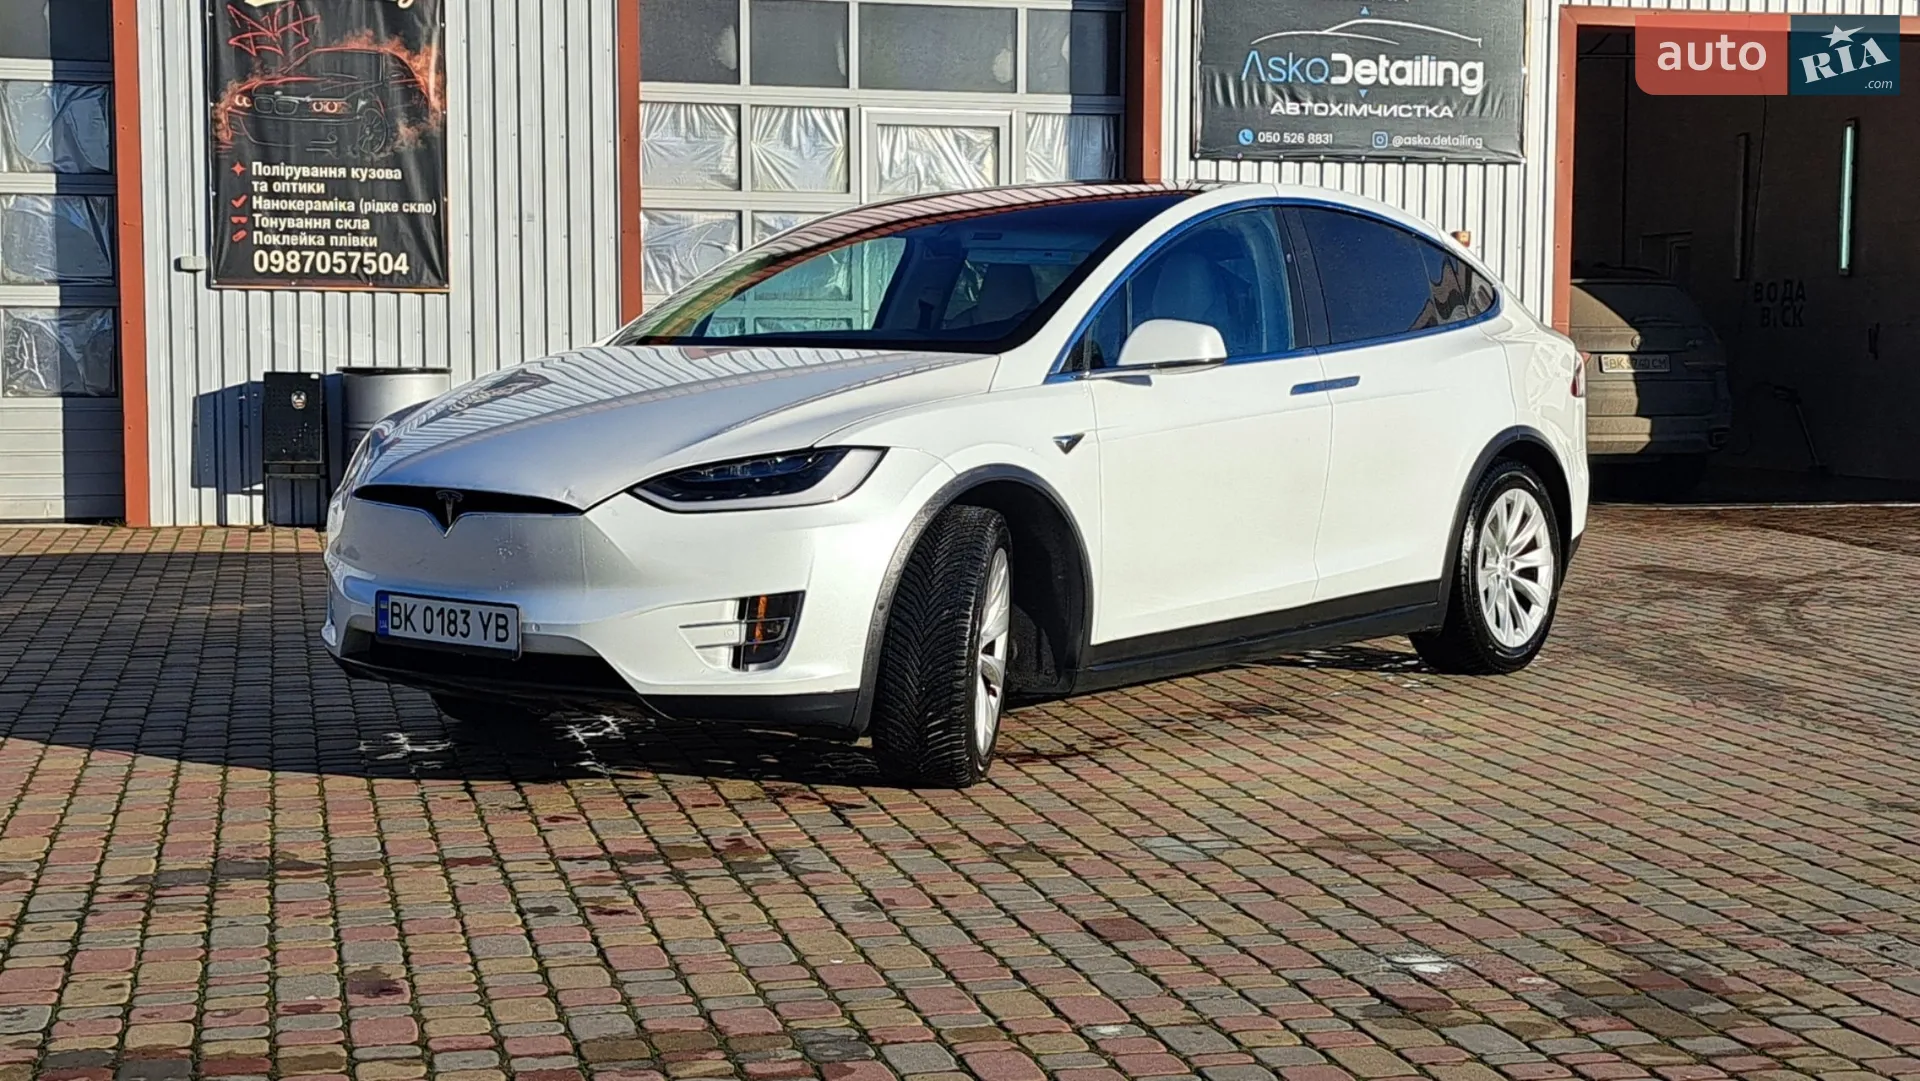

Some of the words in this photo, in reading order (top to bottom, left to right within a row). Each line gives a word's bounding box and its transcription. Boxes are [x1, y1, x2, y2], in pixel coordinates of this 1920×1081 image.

[1270, 102, 1454, 118] АВТОХІМЧИСТКА
[1258, 132, 1282, 143] 050
[1283, 132, 1305, 144] 526
[1307, 133, 1333, 144] 8831
[1392, 134, 1483, 149] @asko.detailing
[252, 161, 347, 181] Полірування
[351, 165, 402, 182] кузова
[252, 181, 269, 193] та
[272, 183, 325, 195] оптики
[252, 197, 355, 214] Нанокераміка
[359, 199, 399, 215] (рідке
[402, 201, 437, 216] скло)
[253, 214, 331, 231] Тонування
[335, 218, 370, 231] скла
[253, 231, 325, 247] Поклейка
[330, 234, 378, 248] плівки
[253, 250, 409, 275] 0987057504
[1753, 279, 1807, 306] ВОДА
[390, 601, 417, 633] BK
[423, 606, 471, 639] 0183
[478, 611, 510, 643] YB
